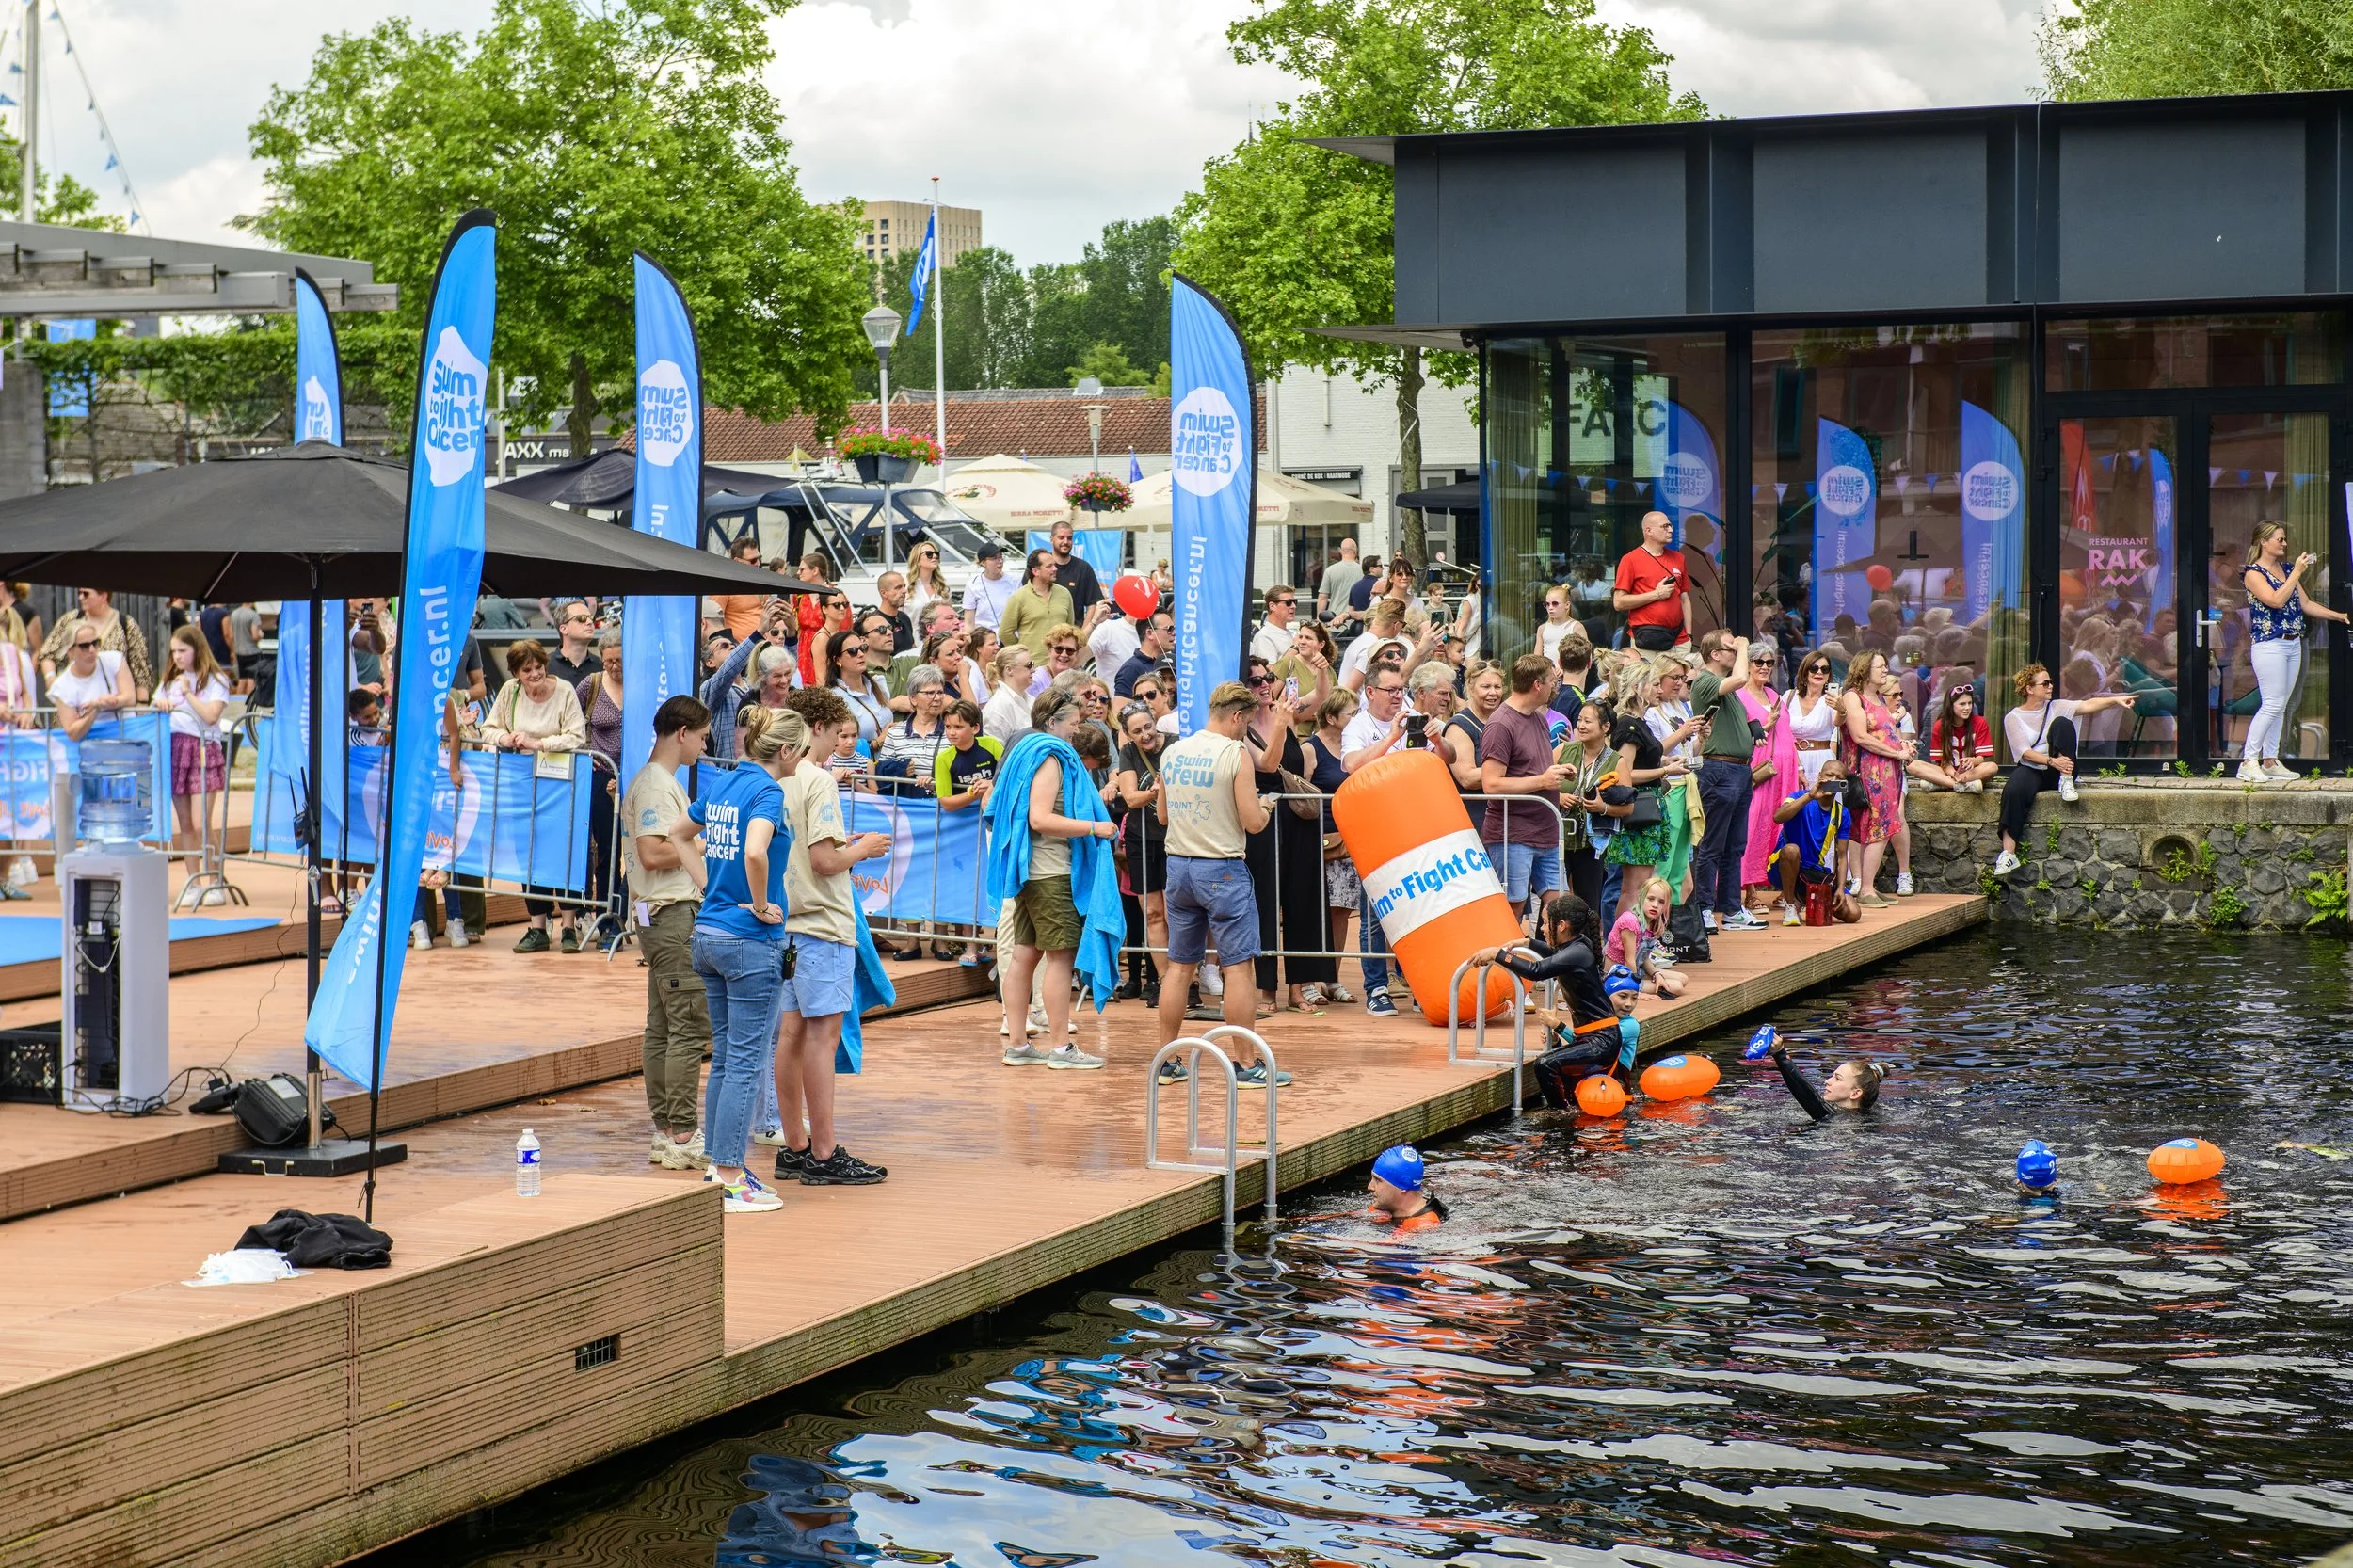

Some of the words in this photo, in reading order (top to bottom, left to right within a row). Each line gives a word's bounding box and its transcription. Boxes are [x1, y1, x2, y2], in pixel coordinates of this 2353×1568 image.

[2089, 537, 2149, 547] RESTAURANT
[2088, 549, 2149, 570] RAK
[1162, 760, 1215, 789] Crew
[706, 799, 739, 824] wim
[705, 843, 740, 861] ancer
[1389, 887, 1403, 900] to
[1401, 854, 1467, 900] Fight
